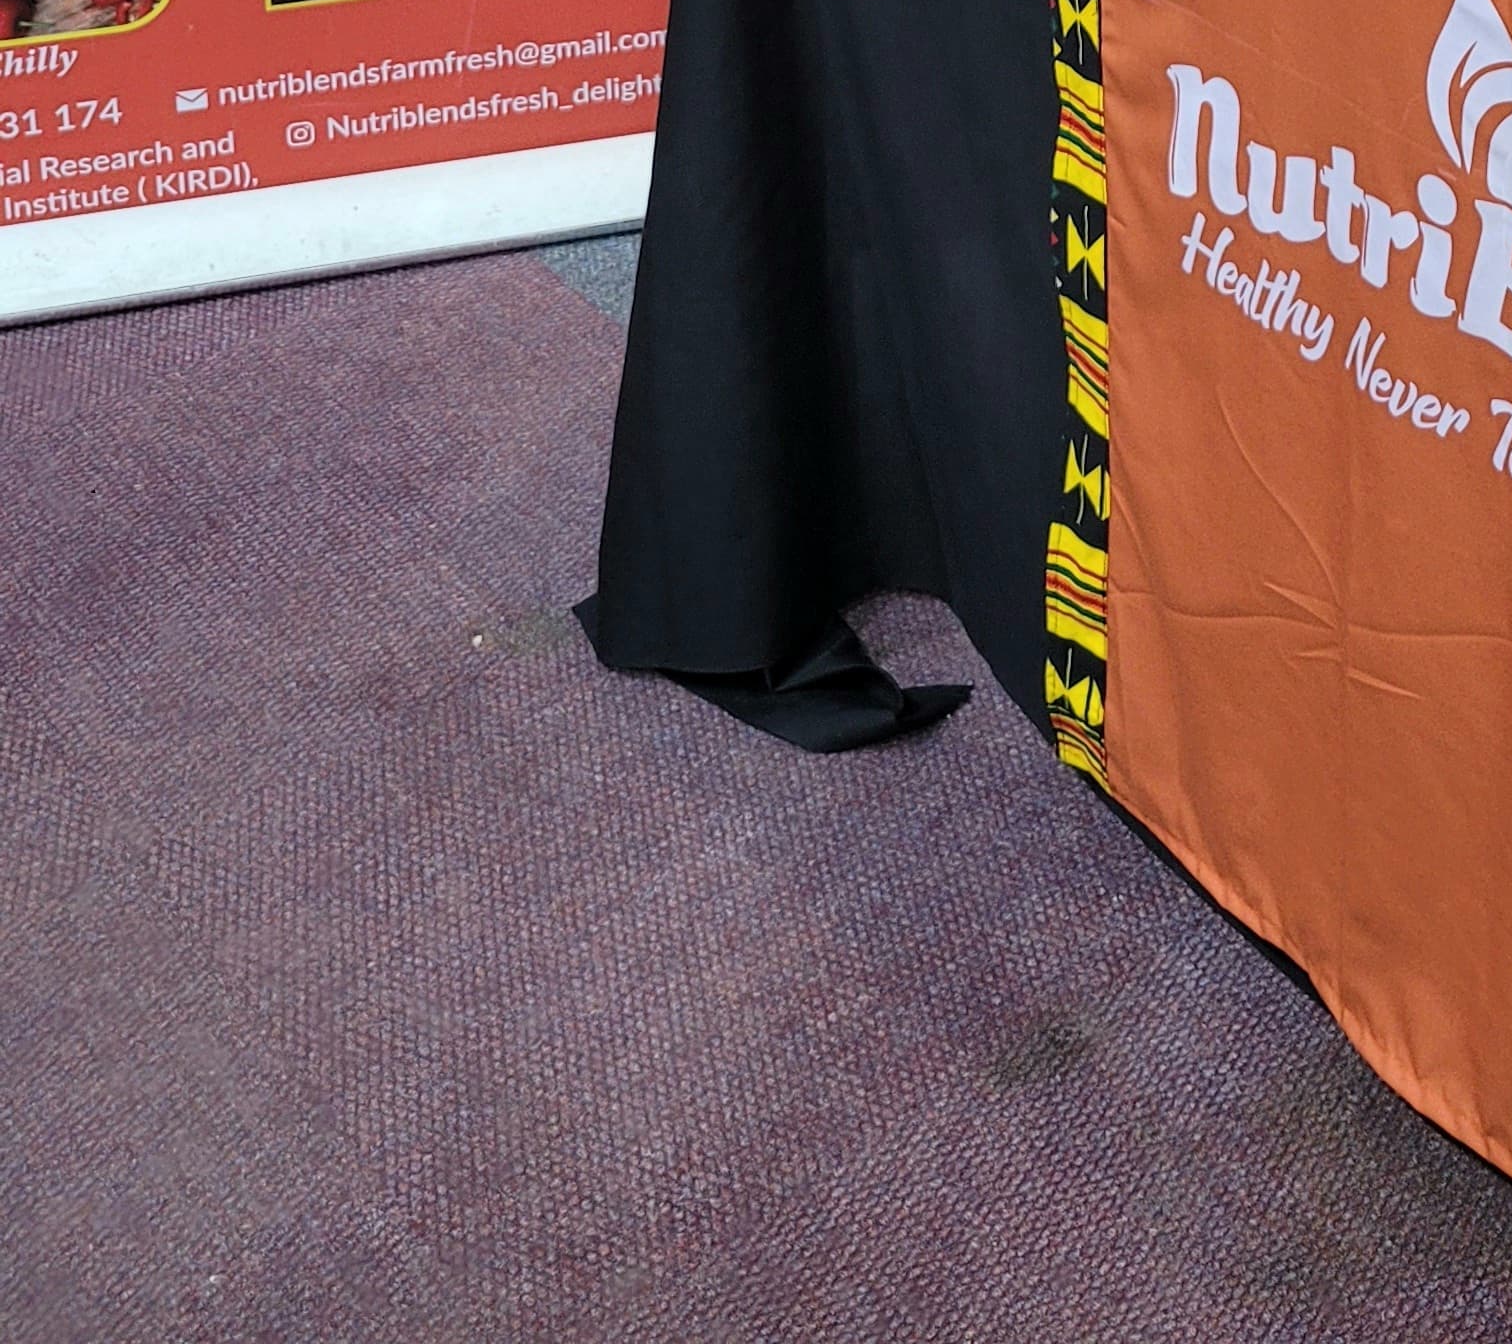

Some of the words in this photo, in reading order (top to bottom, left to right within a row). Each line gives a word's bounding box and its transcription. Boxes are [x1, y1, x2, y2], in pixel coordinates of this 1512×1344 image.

[219, 29, 667, 106] nutriblendsfarmfresh@gmail.com
[55, 97, 122, 133] 174
[41, 141, 173, 180] Research
[182, 131, 235, 162] and
[5, 184, 129, 220] Institute
[1181, 213, 1336, 363] Healthy
[1344, 317, 1471, 439] Never
